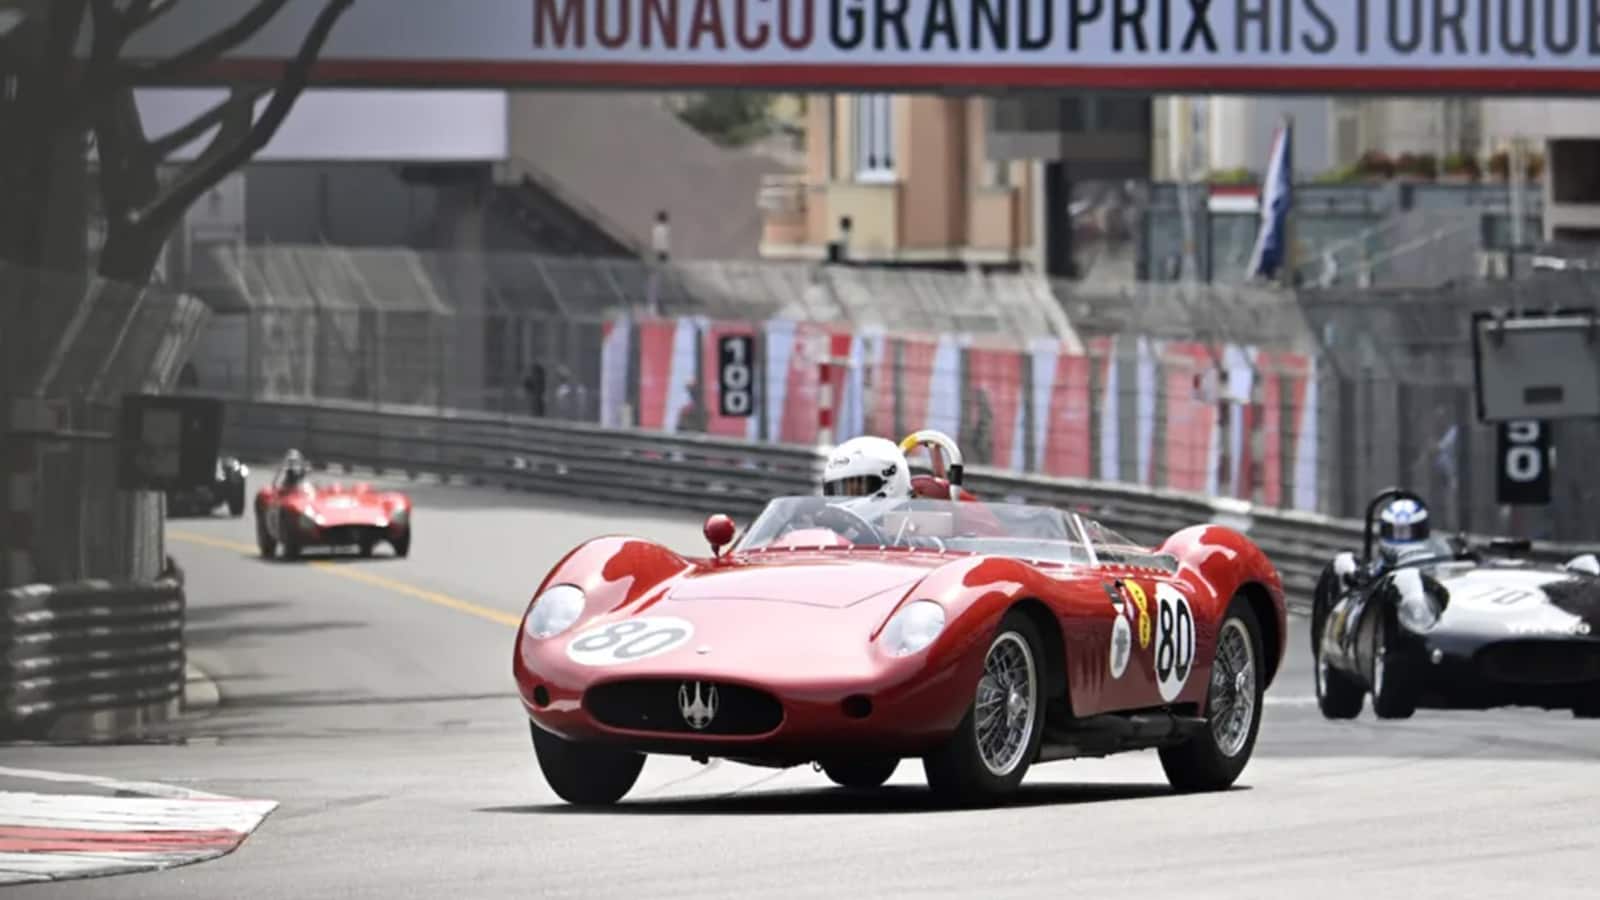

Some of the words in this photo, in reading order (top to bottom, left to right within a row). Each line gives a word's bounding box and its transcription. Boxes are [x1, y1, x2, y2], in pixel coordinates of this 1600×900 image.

[532, 0, 815, 50] MONACO
[828, 0, 1055, 51] GRAND
[1067, 0, 1219, 52] PRIX
[723, 338, 749, 414] 100
[570, 620, 689, 660] 80
[1156, 598, 1192, 683] 80
